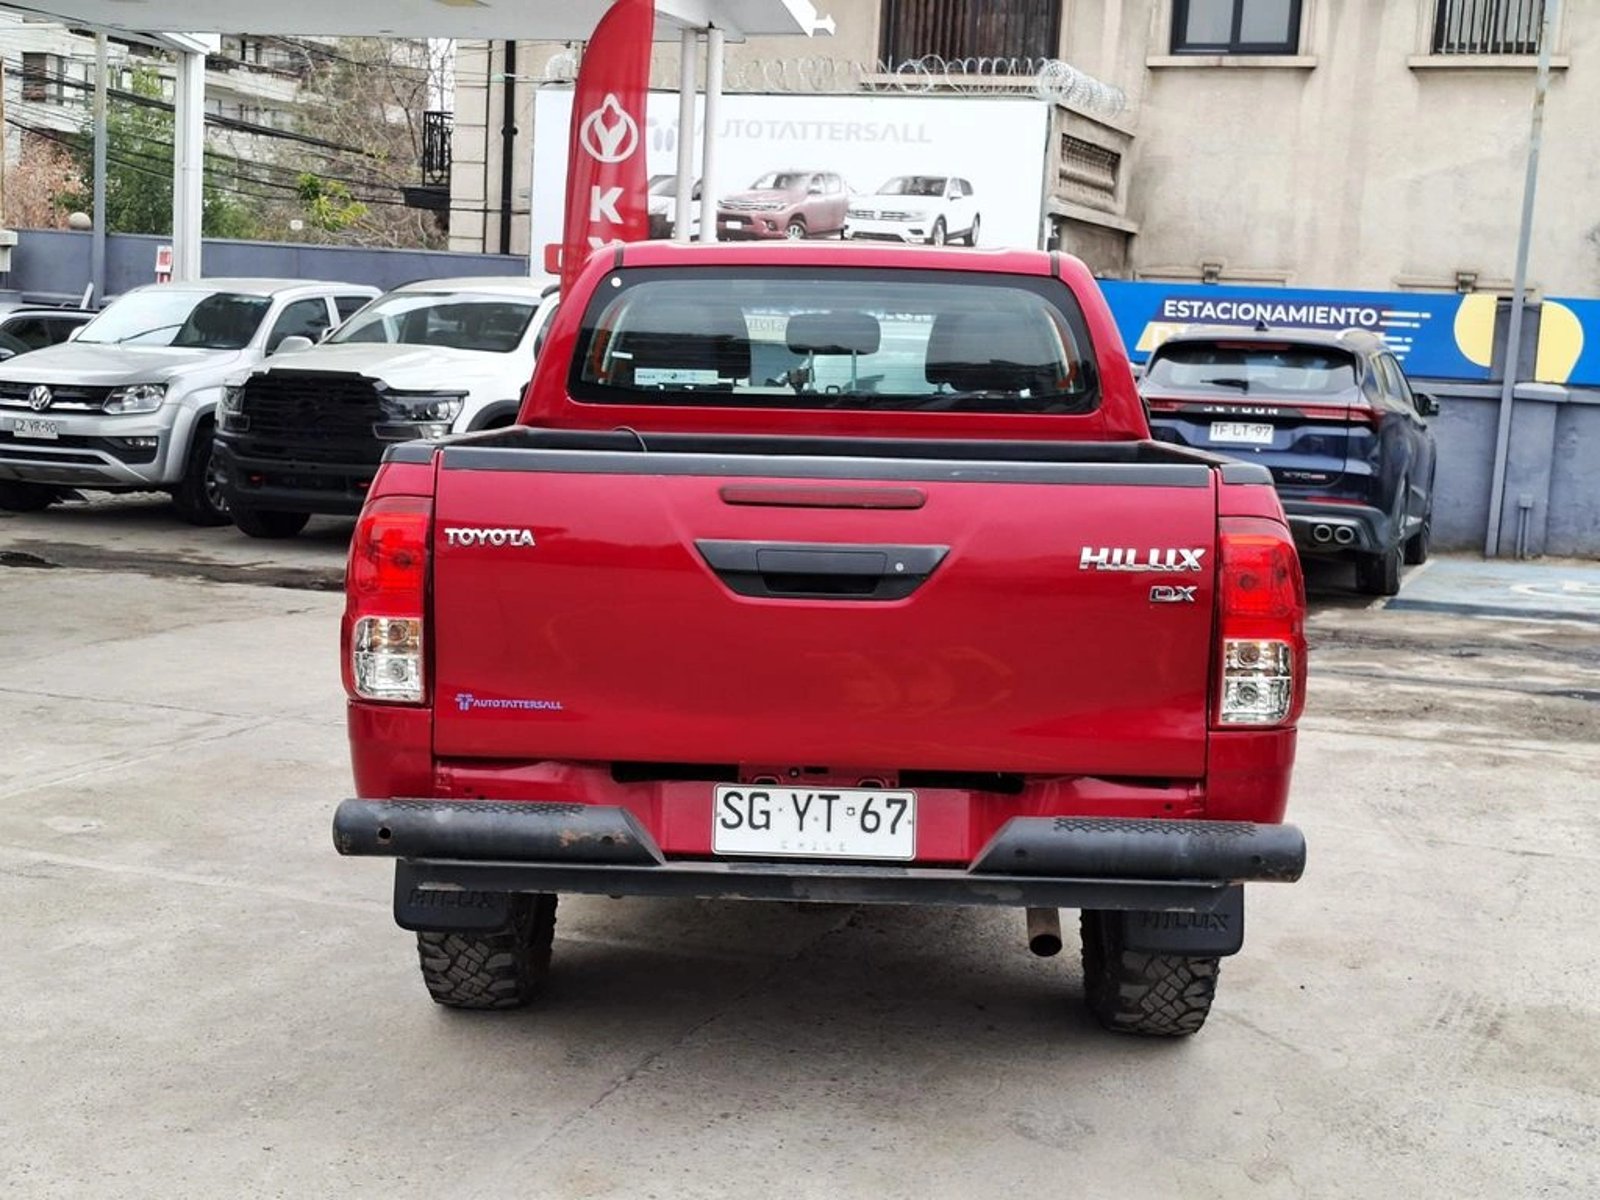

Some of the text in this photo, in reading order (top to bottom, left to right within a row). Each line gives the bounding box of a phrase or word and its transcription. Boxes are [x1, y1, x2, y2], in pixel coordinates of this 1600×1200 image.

[694, 118, 932, 143] UTOTATTERSALL
[1163, 299, 1378, 326] ESTACIONAMIENTO
[444, 527, 536, 546] TOYOTA
[1079, 546, 1206, 571] HILUX
[1149, 585, 1198, 602] DX
[473, 699, 563, 710] AUTOTATTERSALL
